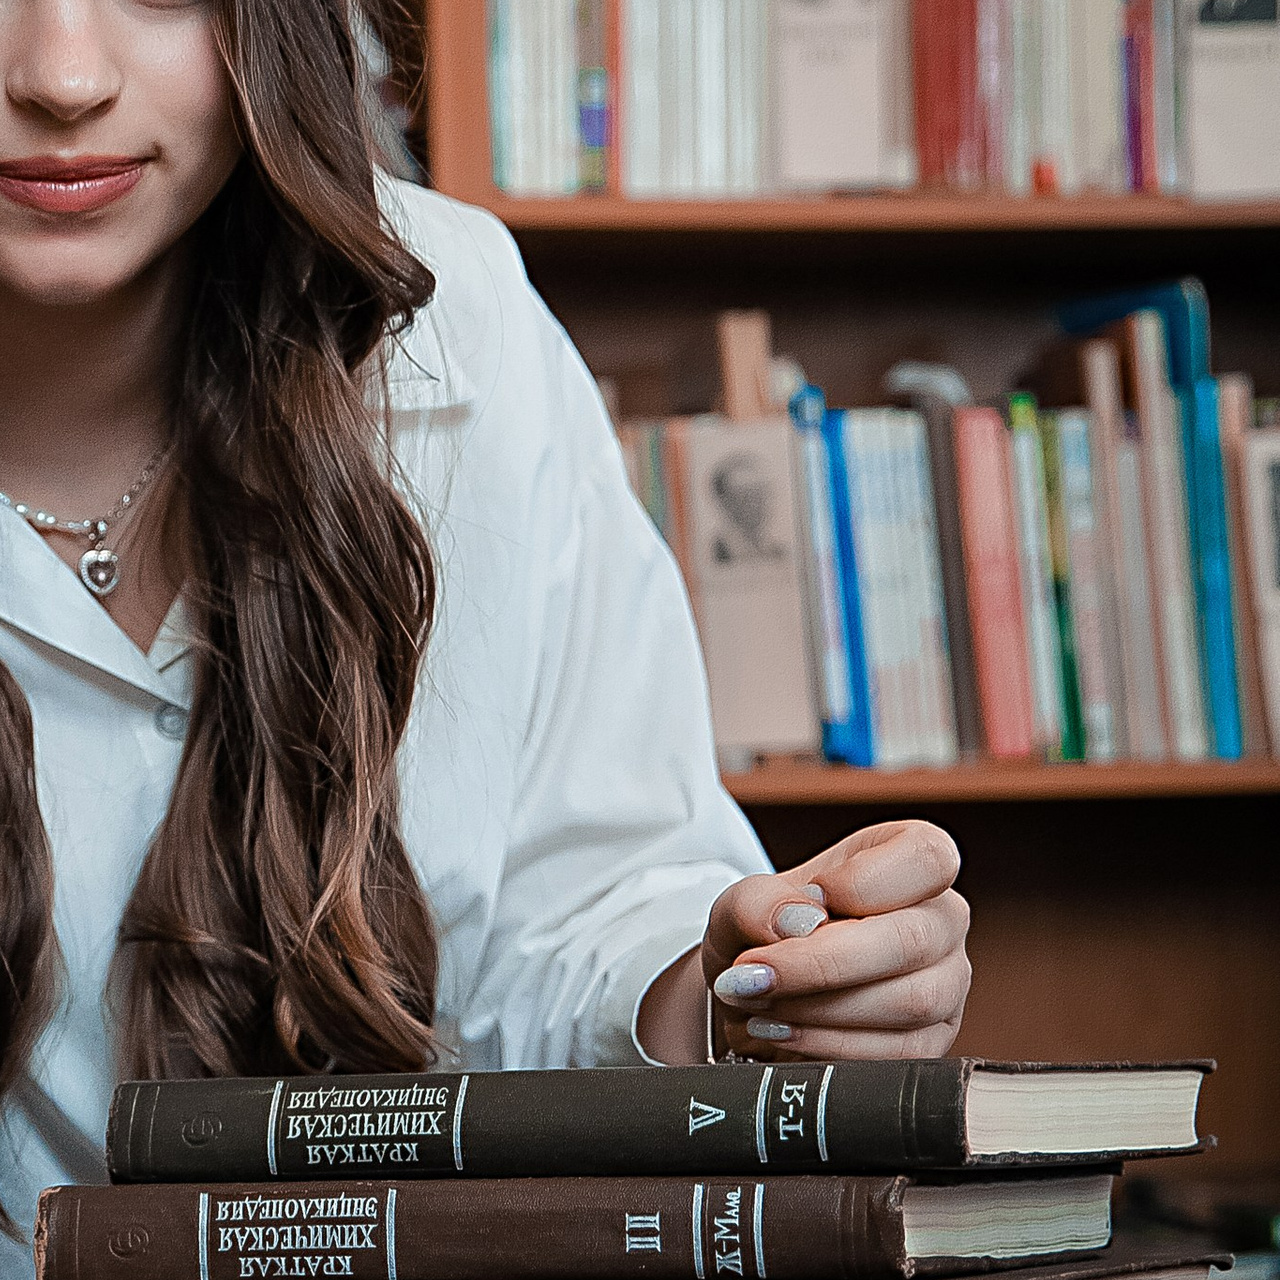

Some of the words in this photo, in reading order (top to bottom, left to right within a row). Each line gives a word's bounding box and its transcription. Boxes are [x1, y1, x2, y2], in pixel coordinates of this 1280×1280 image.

[287, 1083, 449, 1109] ЭНЦИКЛОПЕДИЯ
[286, 1110, 447, 1139] ХИМИЧЕСКАЯ
[689, 1096, 726, 1136] V
[306, 1142, 420, 1165] КРАТКАЯ
[215, 1192, 379, 1221] ЭНЦИКЛОПЕДИЯ
[218, 1223, 379, 1252] ХИМИЧЕСКАЯ
[239, 1256, 354, 1278] КРАТКАЯ
